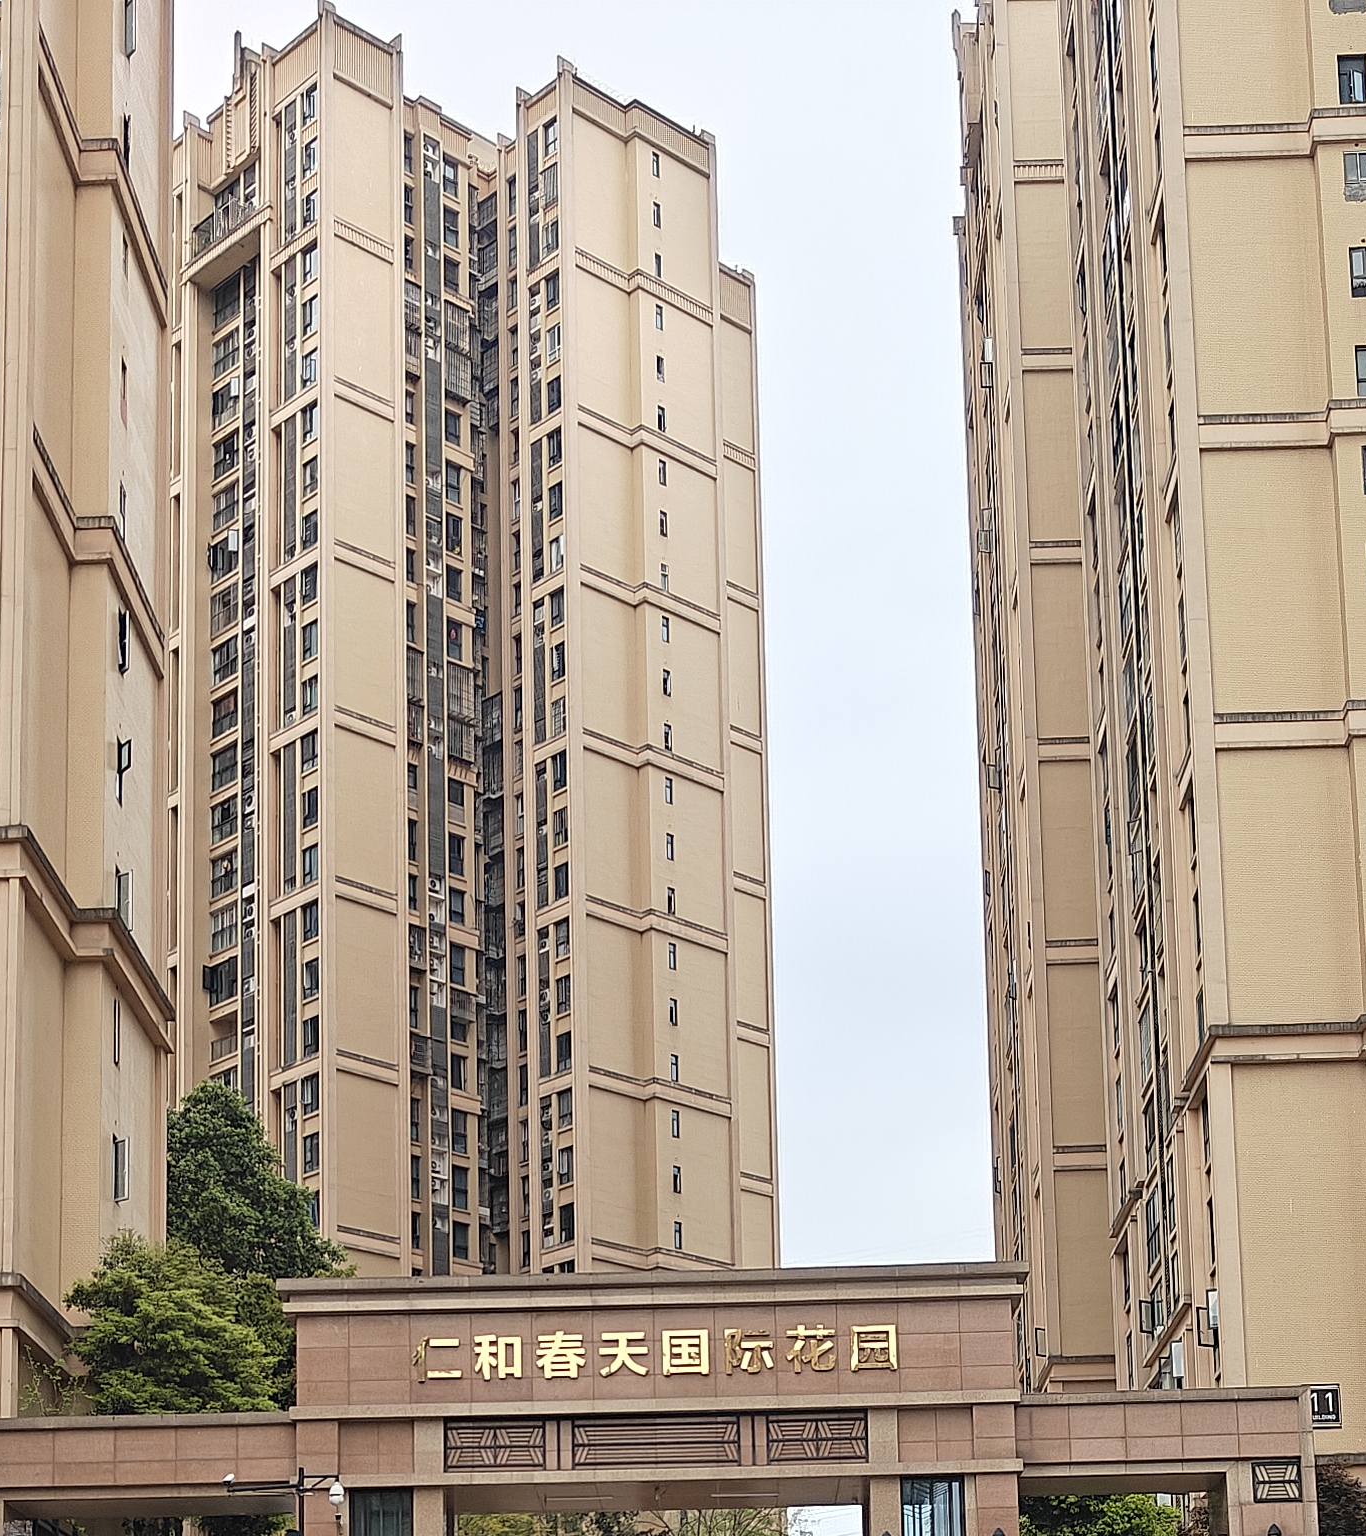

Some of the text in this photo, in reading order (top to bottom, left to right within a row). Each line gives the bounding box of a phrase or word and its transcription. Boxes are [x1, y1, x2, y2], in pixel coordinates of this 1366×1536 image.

[415, 1325, 899, 1383] 仁和春天国际花园
